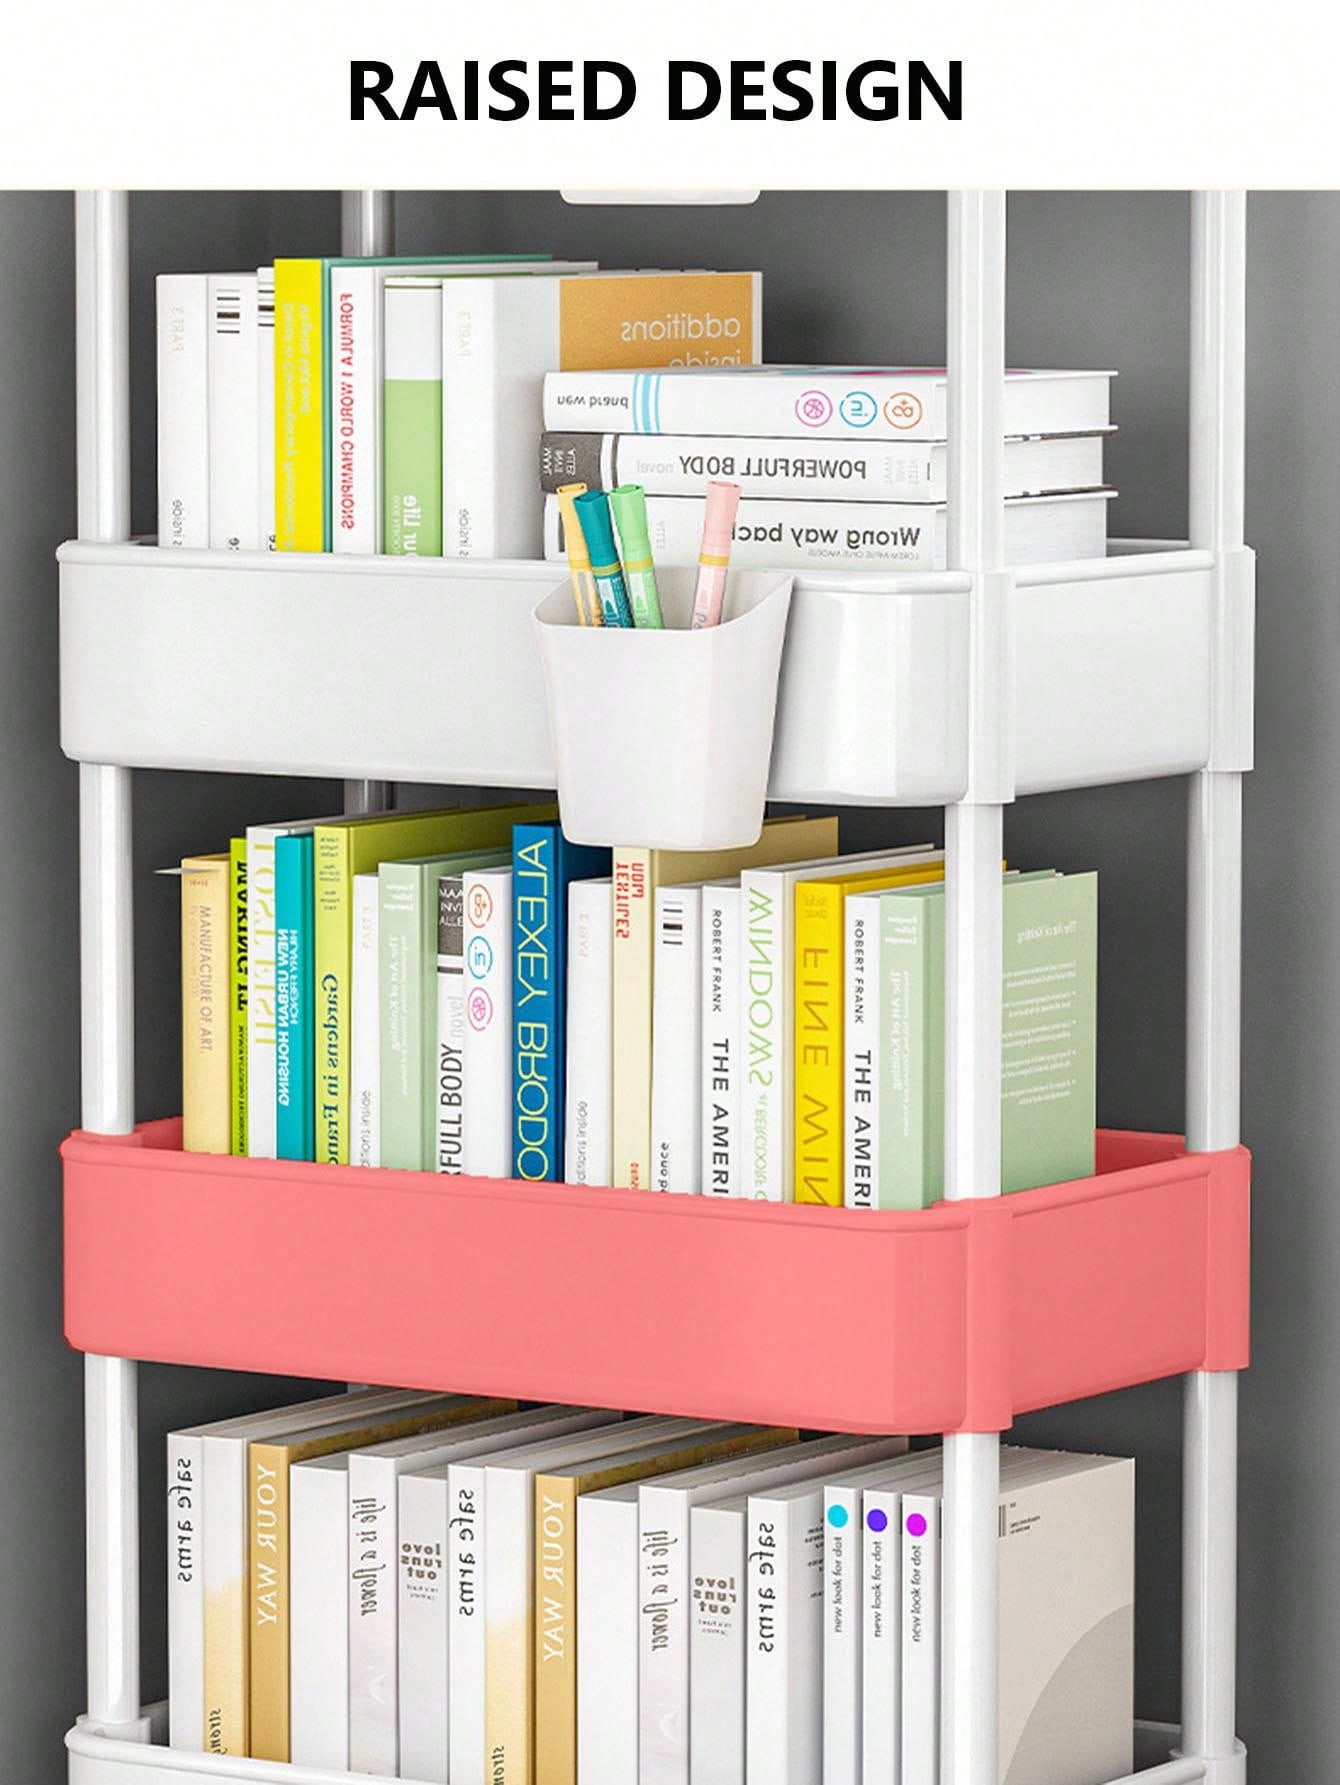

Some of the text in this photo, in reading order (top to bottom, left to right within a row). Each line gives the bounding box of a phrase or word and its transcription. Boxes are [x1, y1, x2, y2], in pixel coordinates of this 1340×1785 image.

[199, 905, 213, 1002] MANUFACTURE
[711, 908, 722, 1013] ROBERT FRANK
[854, 919, 864, 1024] ROBERT FRANK
[199, 1006, 212, 1023] OF
[446, 995, 464, 1038] novel
[439, 1042, 463, 1107] BODY
[712, 1038, 729, 1195] THE AMERI
[659, 1142, 670, 1176] once
[854, 1050, 871, 1208] THE AMERI
[833, 1536, 843, 1634] new look for dot
[872, 1540, 882, 1638] new look for dot
[911, 1545, 921, 1643] new look for dot
